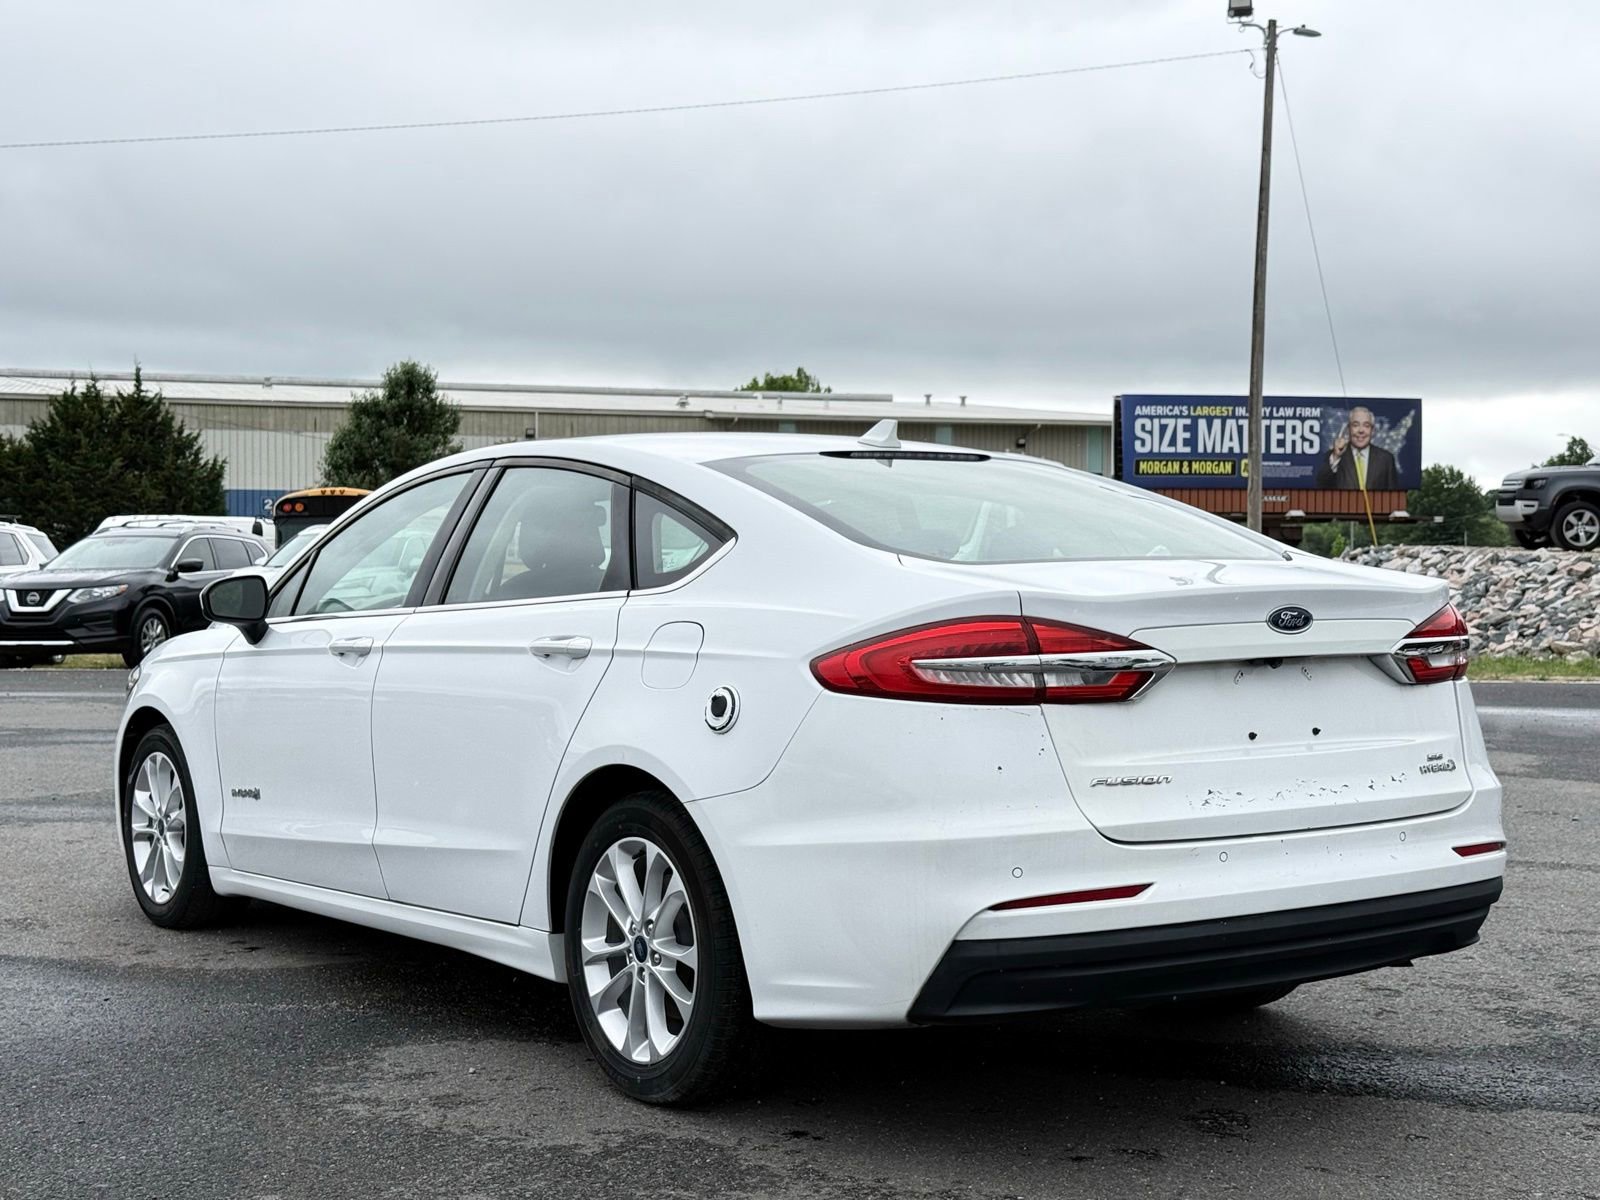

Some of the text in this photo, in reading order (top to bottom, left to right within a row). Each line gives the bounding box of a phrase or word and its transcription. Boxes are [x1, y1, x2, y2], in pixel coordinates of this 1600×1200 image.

[1134, 405, 1320, 417] AMERICA'S LARGEST INY LAW FIRM
[1134, 418, 1320, 454] SIZE MATTERS
[1140, 461, 1232, 474] MORGAN & MORGAN
[1279, 611, 1304, 626] Ford
